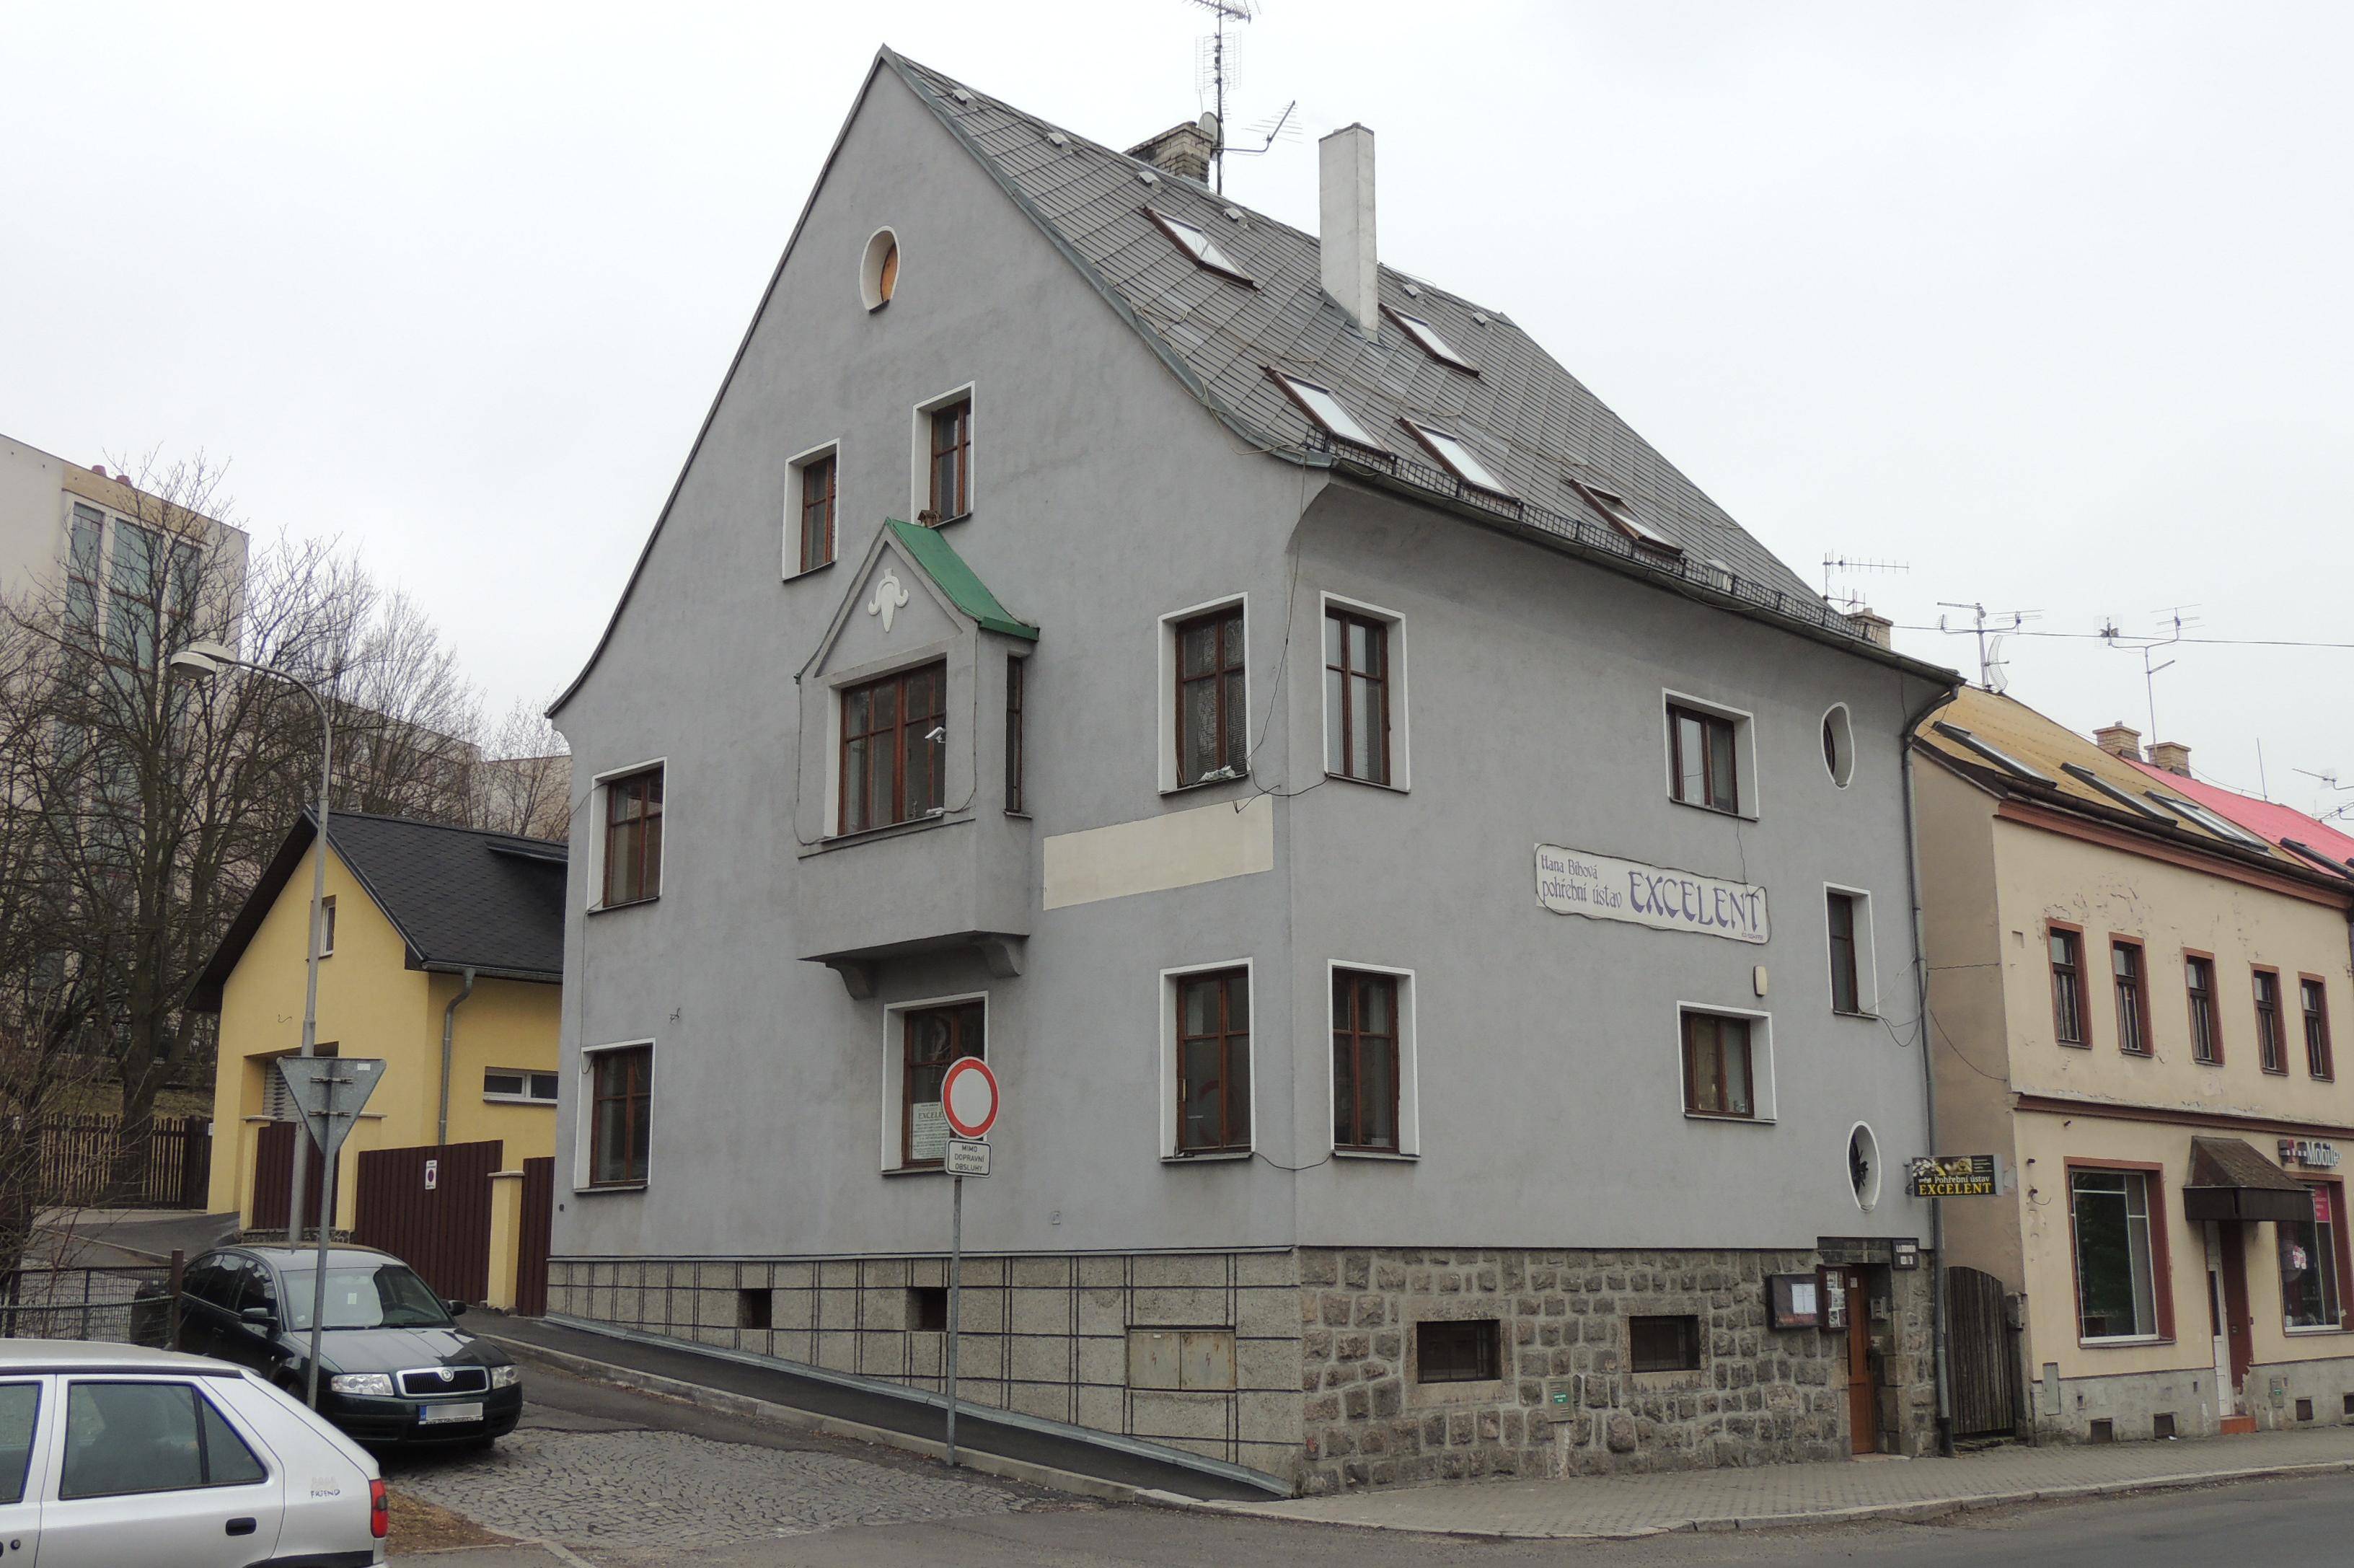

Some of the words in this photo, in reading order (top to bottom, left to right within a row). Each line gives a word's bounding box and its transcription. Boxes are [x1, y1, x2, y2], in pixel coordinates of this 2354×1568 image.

[1540, 854, 1564, 873] Hana
[1628, 870, 1760, 933] EXCELENT
[961, 1144, 978, 1153] MIMO
[954, 1163, 983, 1171] OBSLUHY
[1918, 1183, 1992, 1195] EXCELENT
